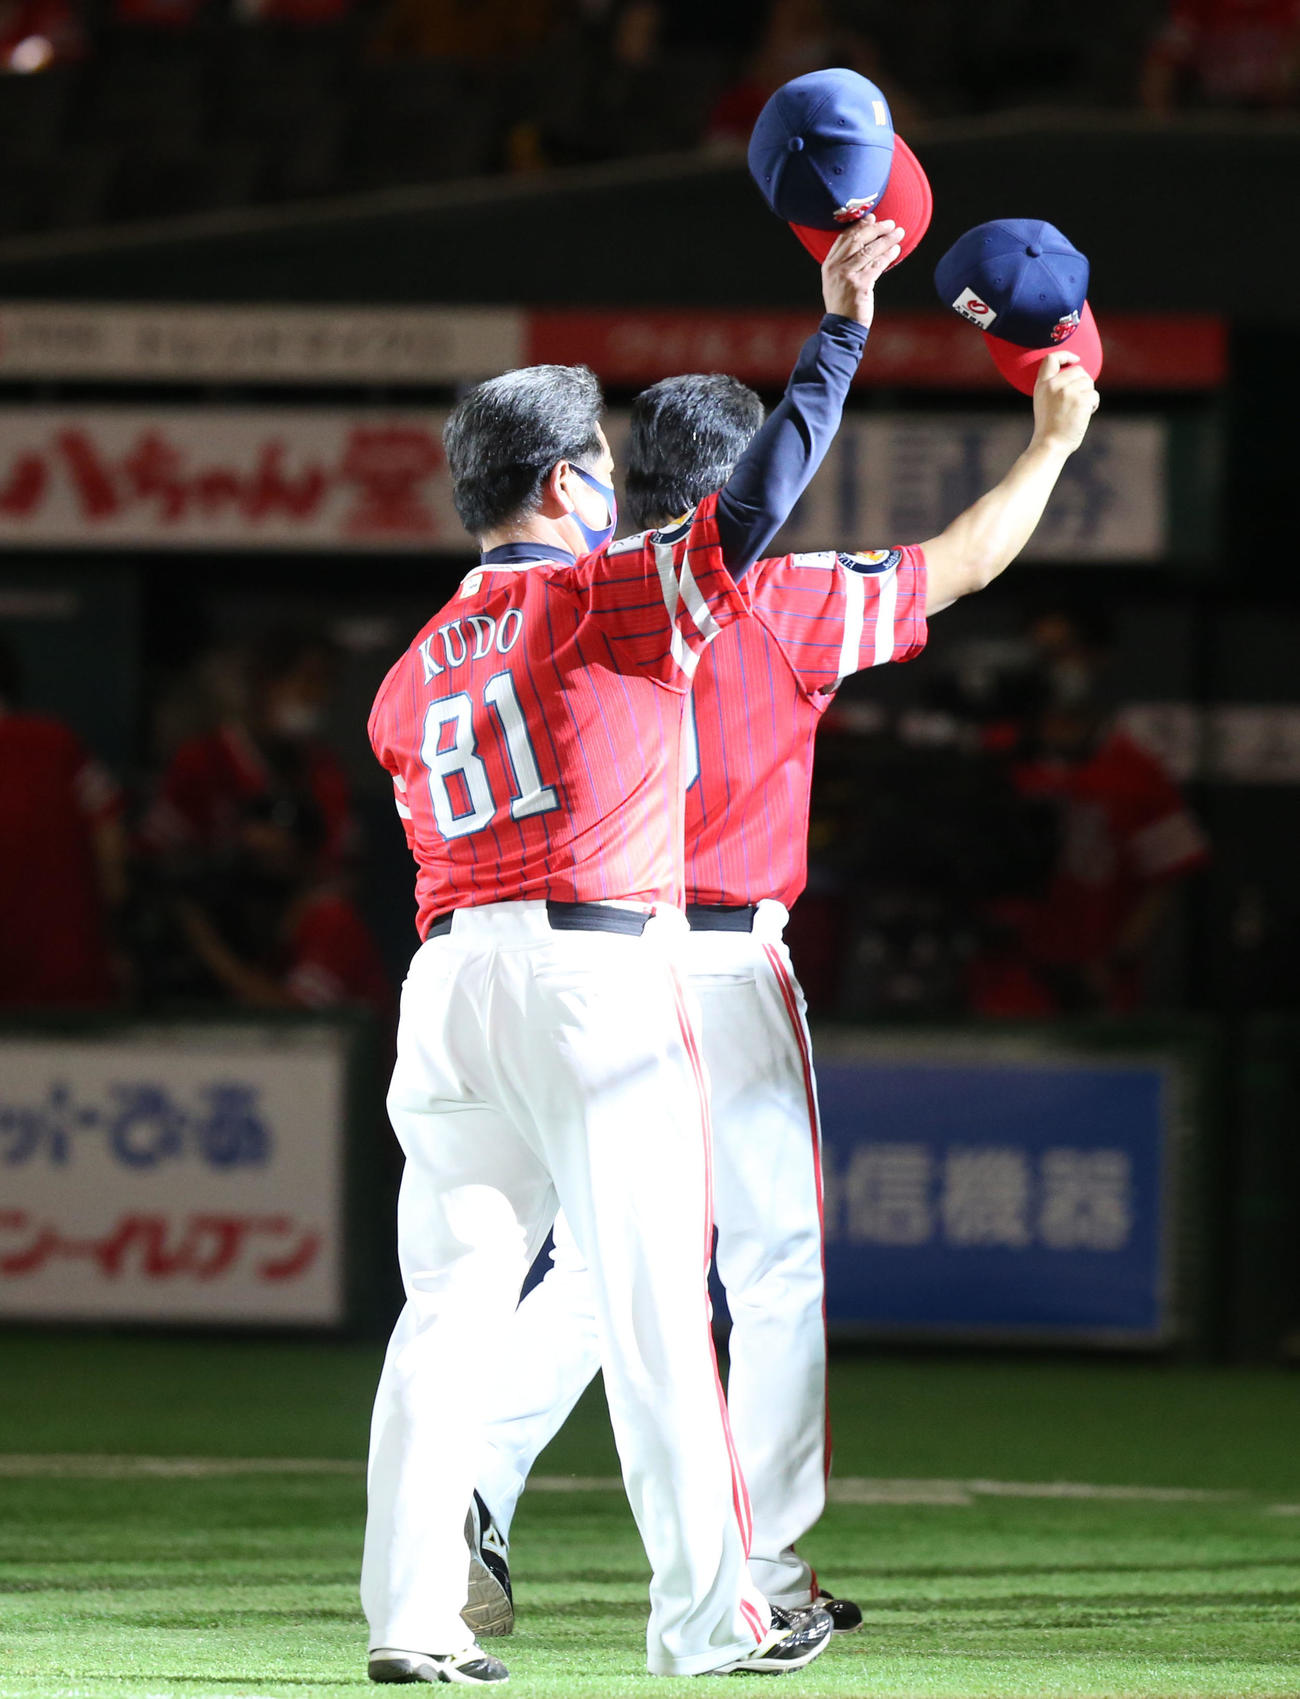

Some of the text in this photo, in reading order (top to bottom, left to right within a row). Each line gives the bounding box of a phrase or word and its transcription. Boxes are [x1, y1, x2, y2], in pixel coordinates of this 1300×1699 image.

[417, 607, 524, 687] KUDO
[419, 667, 563, 843] 81
[822, 1142, 1133, 1252] 信機器
